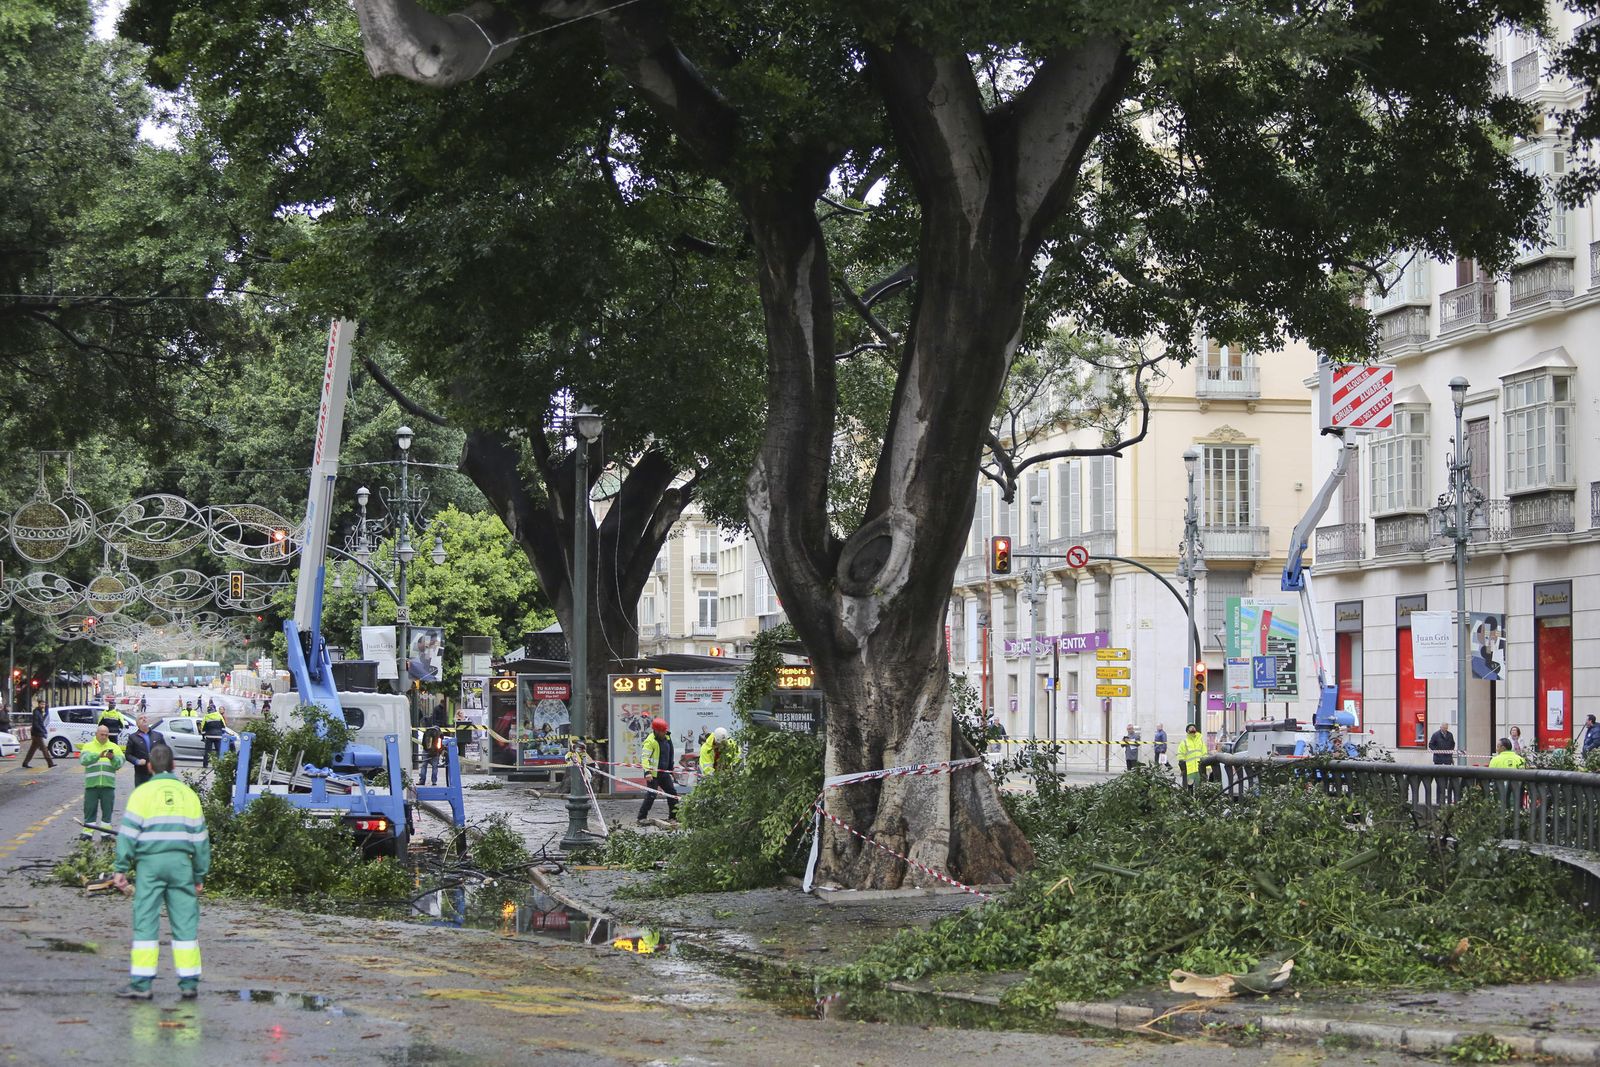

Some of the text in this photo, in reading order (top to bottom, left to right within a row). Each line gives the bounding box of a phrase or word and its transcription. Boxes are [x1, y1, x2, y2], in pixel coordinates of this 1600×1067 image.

[1346, 371, 1370, 391] ALQUILER
[1360, 379, 1386, 402] ALVAREZ
[1058, 637, 1087, 649] DENTIX
[1416, 633, 1450, 643] Juan Gris
[462, 681, 483, 689] QUEEN
[779, 676, 811, 687] 12:00
